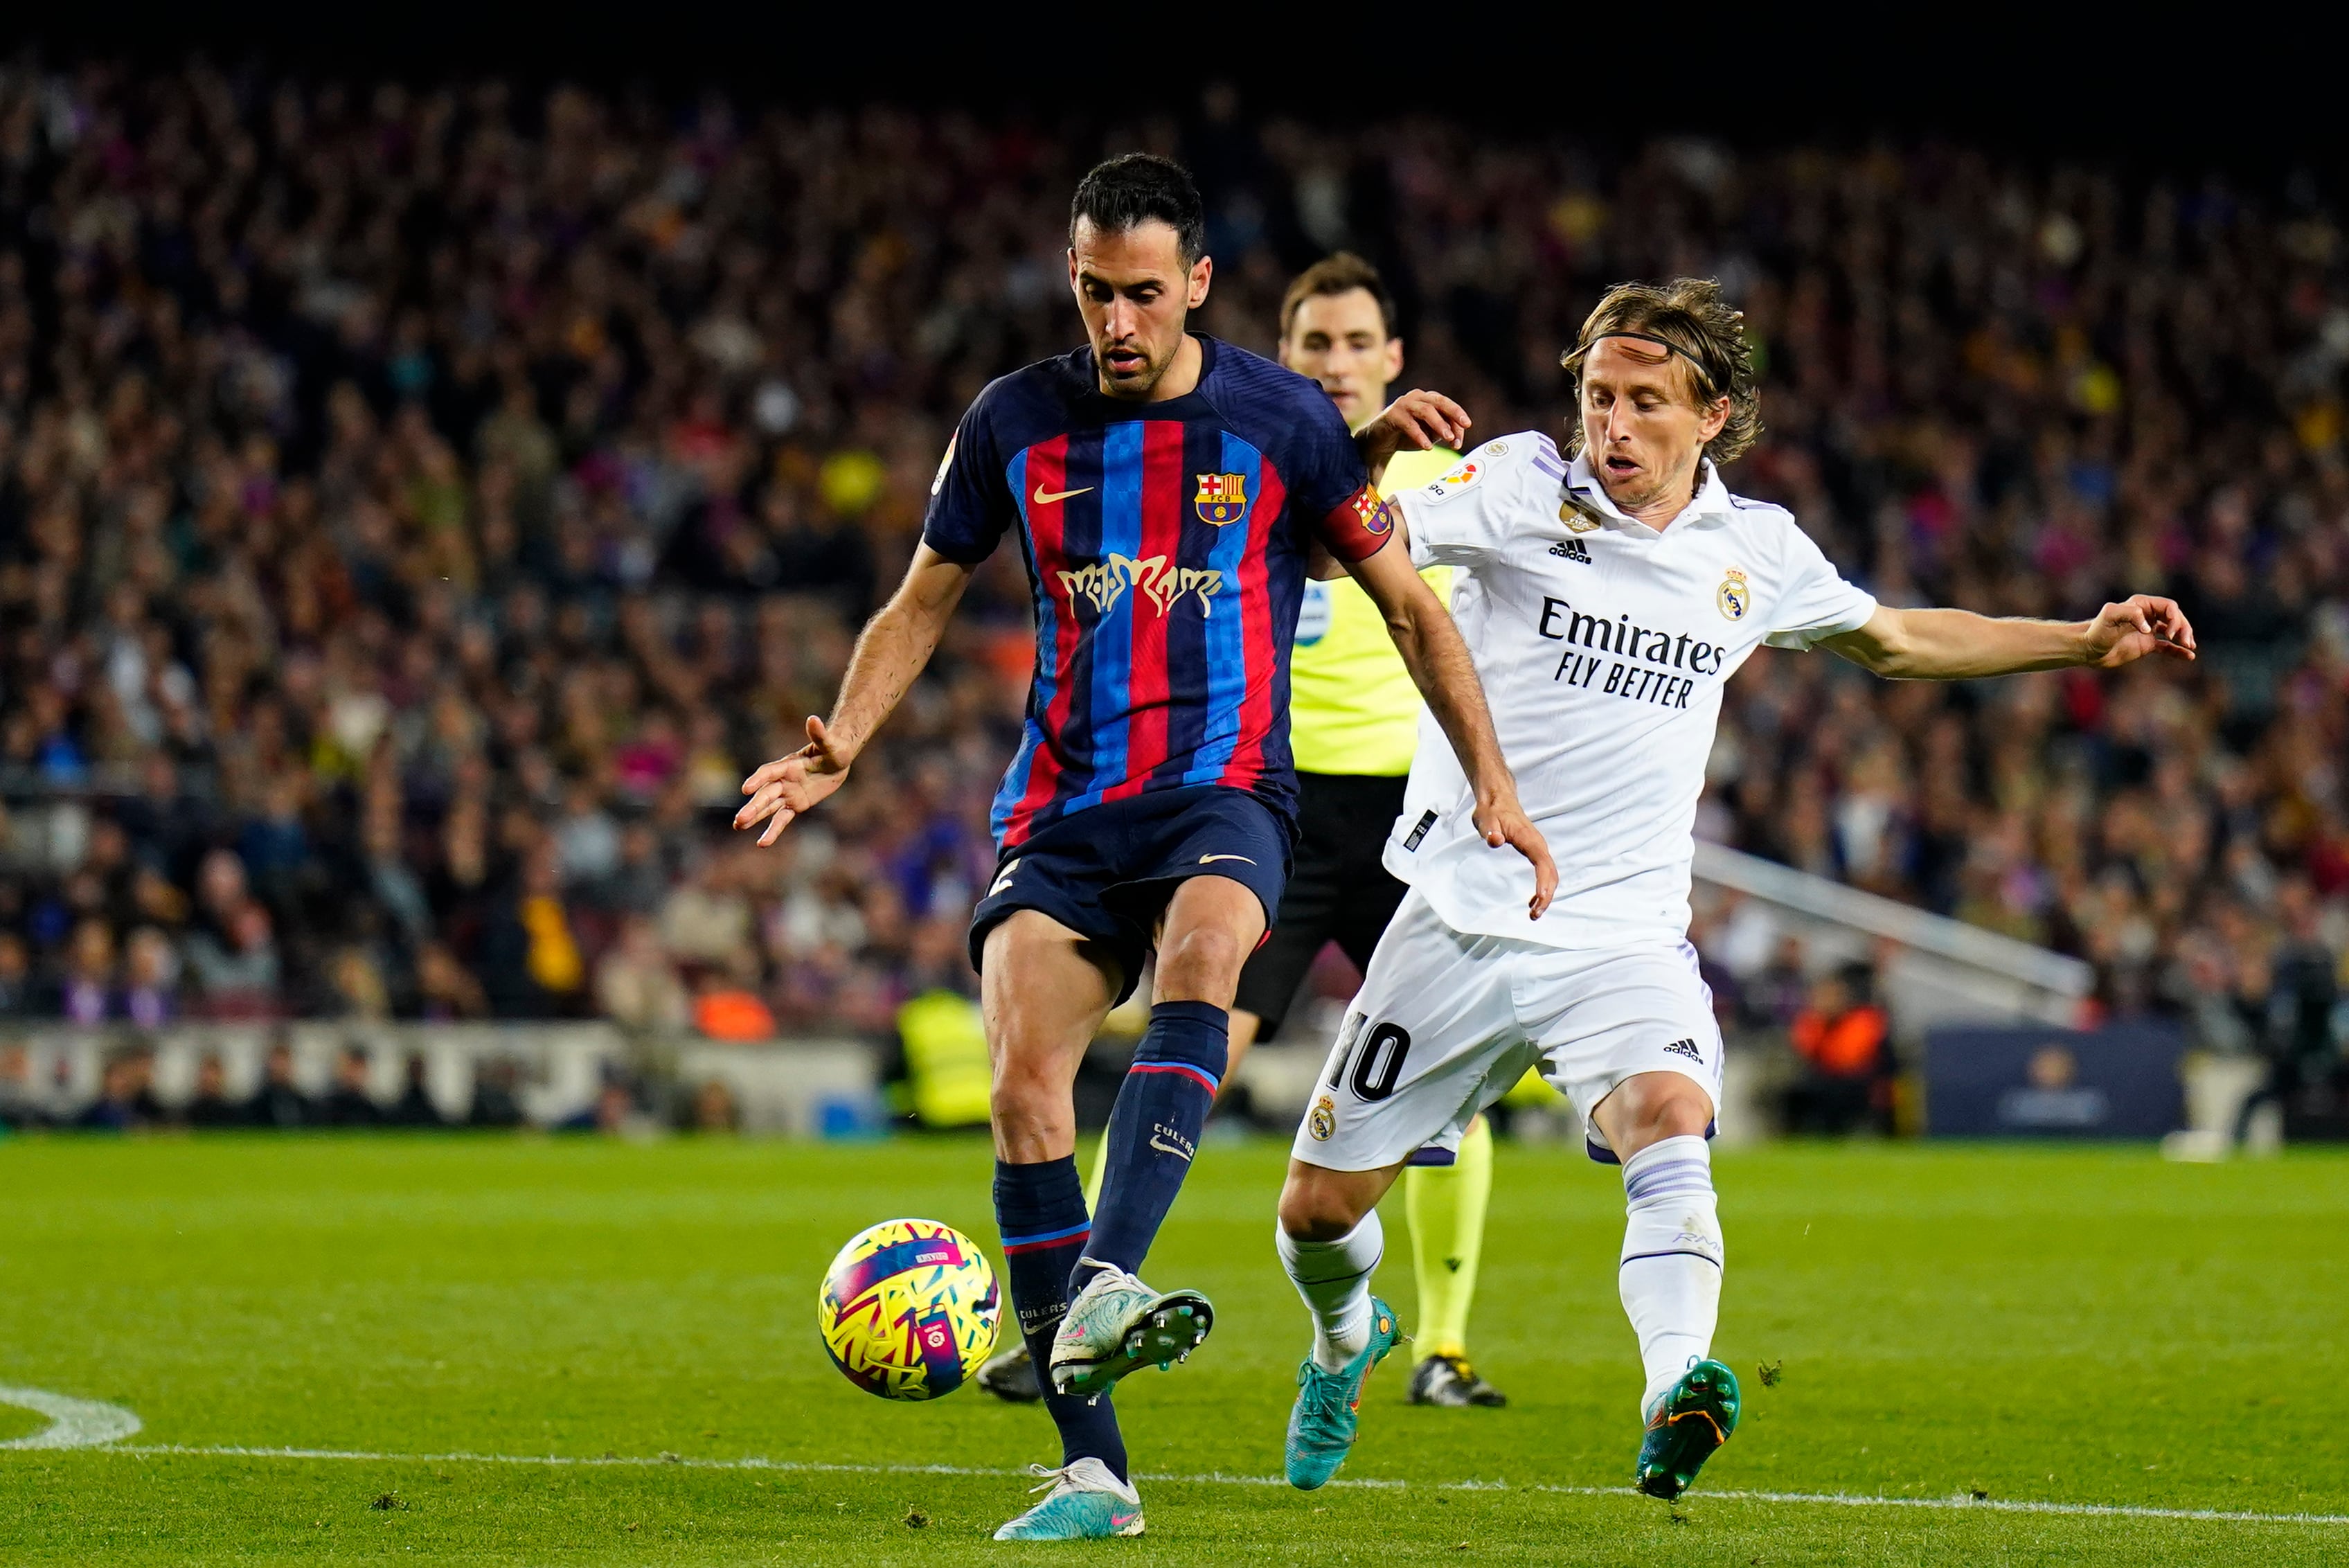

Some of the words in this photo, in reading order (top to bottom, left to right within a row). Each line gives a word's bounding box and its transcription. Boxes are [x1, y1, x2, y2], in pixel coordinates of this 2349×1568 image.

[1548, 546, 1592, 564] adidas
[1539, 596, 1726, 675] Emirates
[1554, 652, 1602, 688] FLY
[1603, 663, 1694, 709] BETTER
[1325, 1011, 1411, 1103] 10
[1663, 1046, 1704, 1065] adidas
